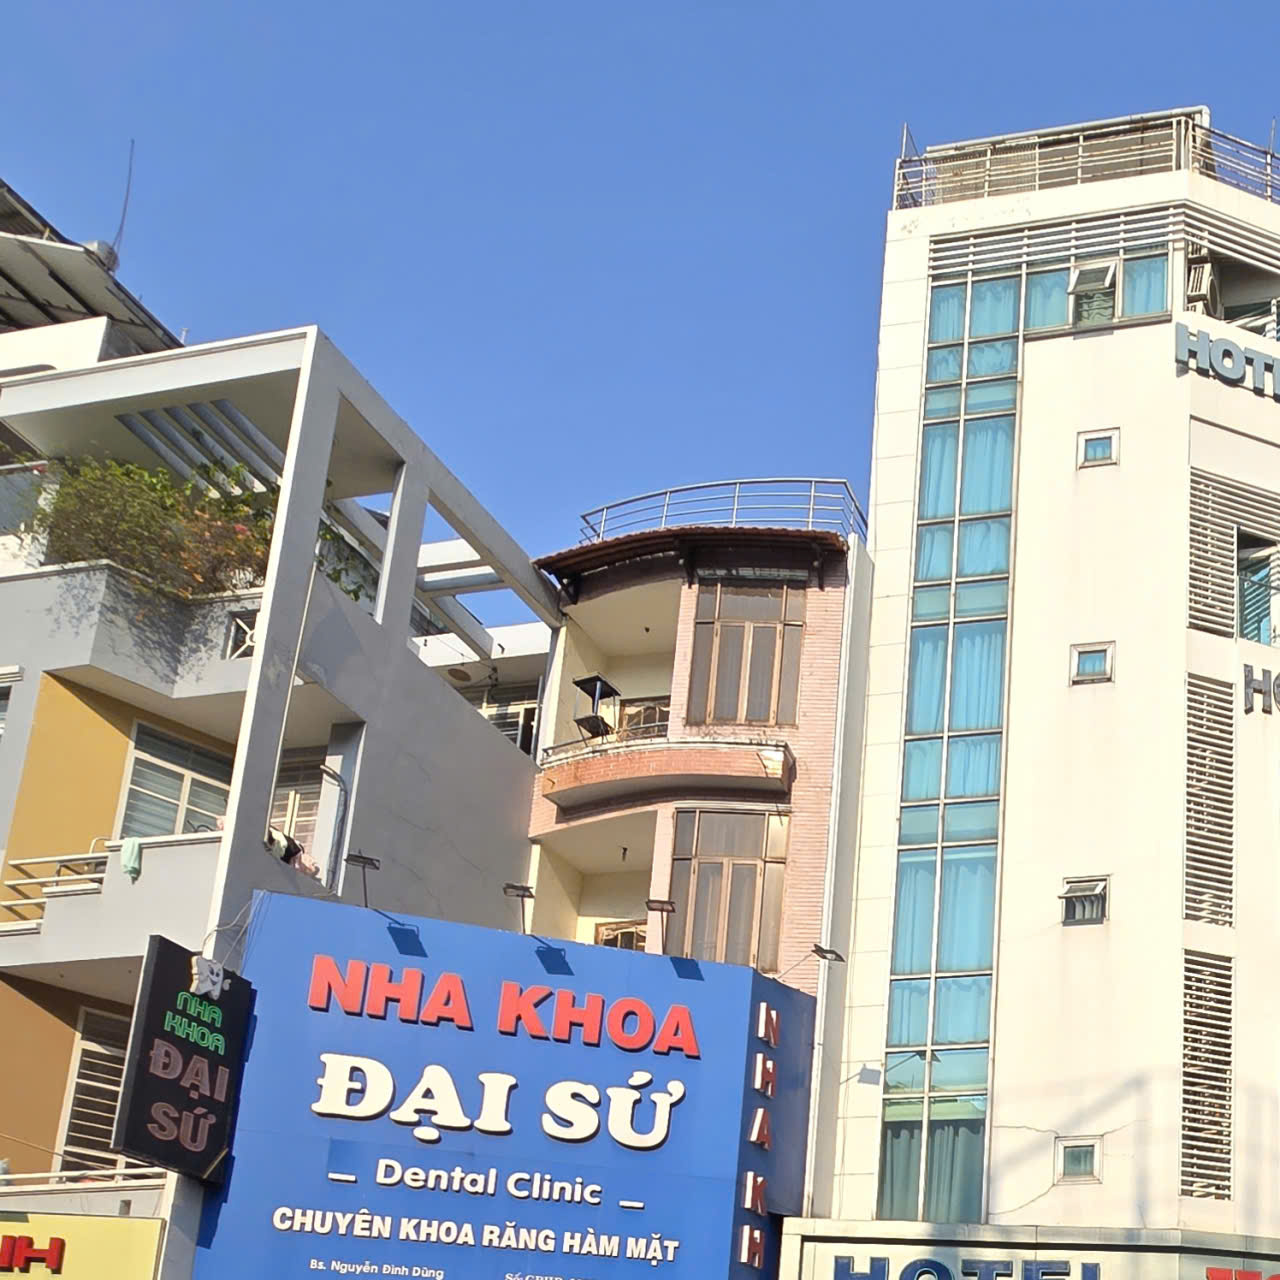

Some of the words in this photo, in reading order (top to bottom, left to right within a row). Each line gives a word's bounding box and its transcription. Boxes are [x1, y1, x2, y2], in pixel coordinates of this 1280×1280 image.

[164, 1012, 226, 1056] KHOA
[176, 990, 225, 1029] NHA
[308, 954, 474, 1030] NHA
[497, 980, 701, 1059] KHOA
[147, 1037, 230, 1103] ĐẠI
[748, 1002, 780, 1151] NHA
[147, 1100, 216, 1153] SỨ
[310, 1052, 518, 1143] ĐẠI
[541, 1071, 686, 1149] SỨ
[376, 1158, 498, 1196] Dental
[506, 1172, 603, 1204] Clinic
[272, 1206, 393, 1240] CHUYÊN
[399, 1217, 476, 1247] KHOA
[481, 1221, 557, 1252] RĂNG
[562, 1228, 620, 1259] HÀM
[625, 1233, 680, 1266] MẶT
[309, 1259, 327, 1271] Bs.
[330, 1260, 379, 1277] Nguyễn
[381, 1263, 409, 1277] Đình
[411, 1266, 445, 1280] Dũng
